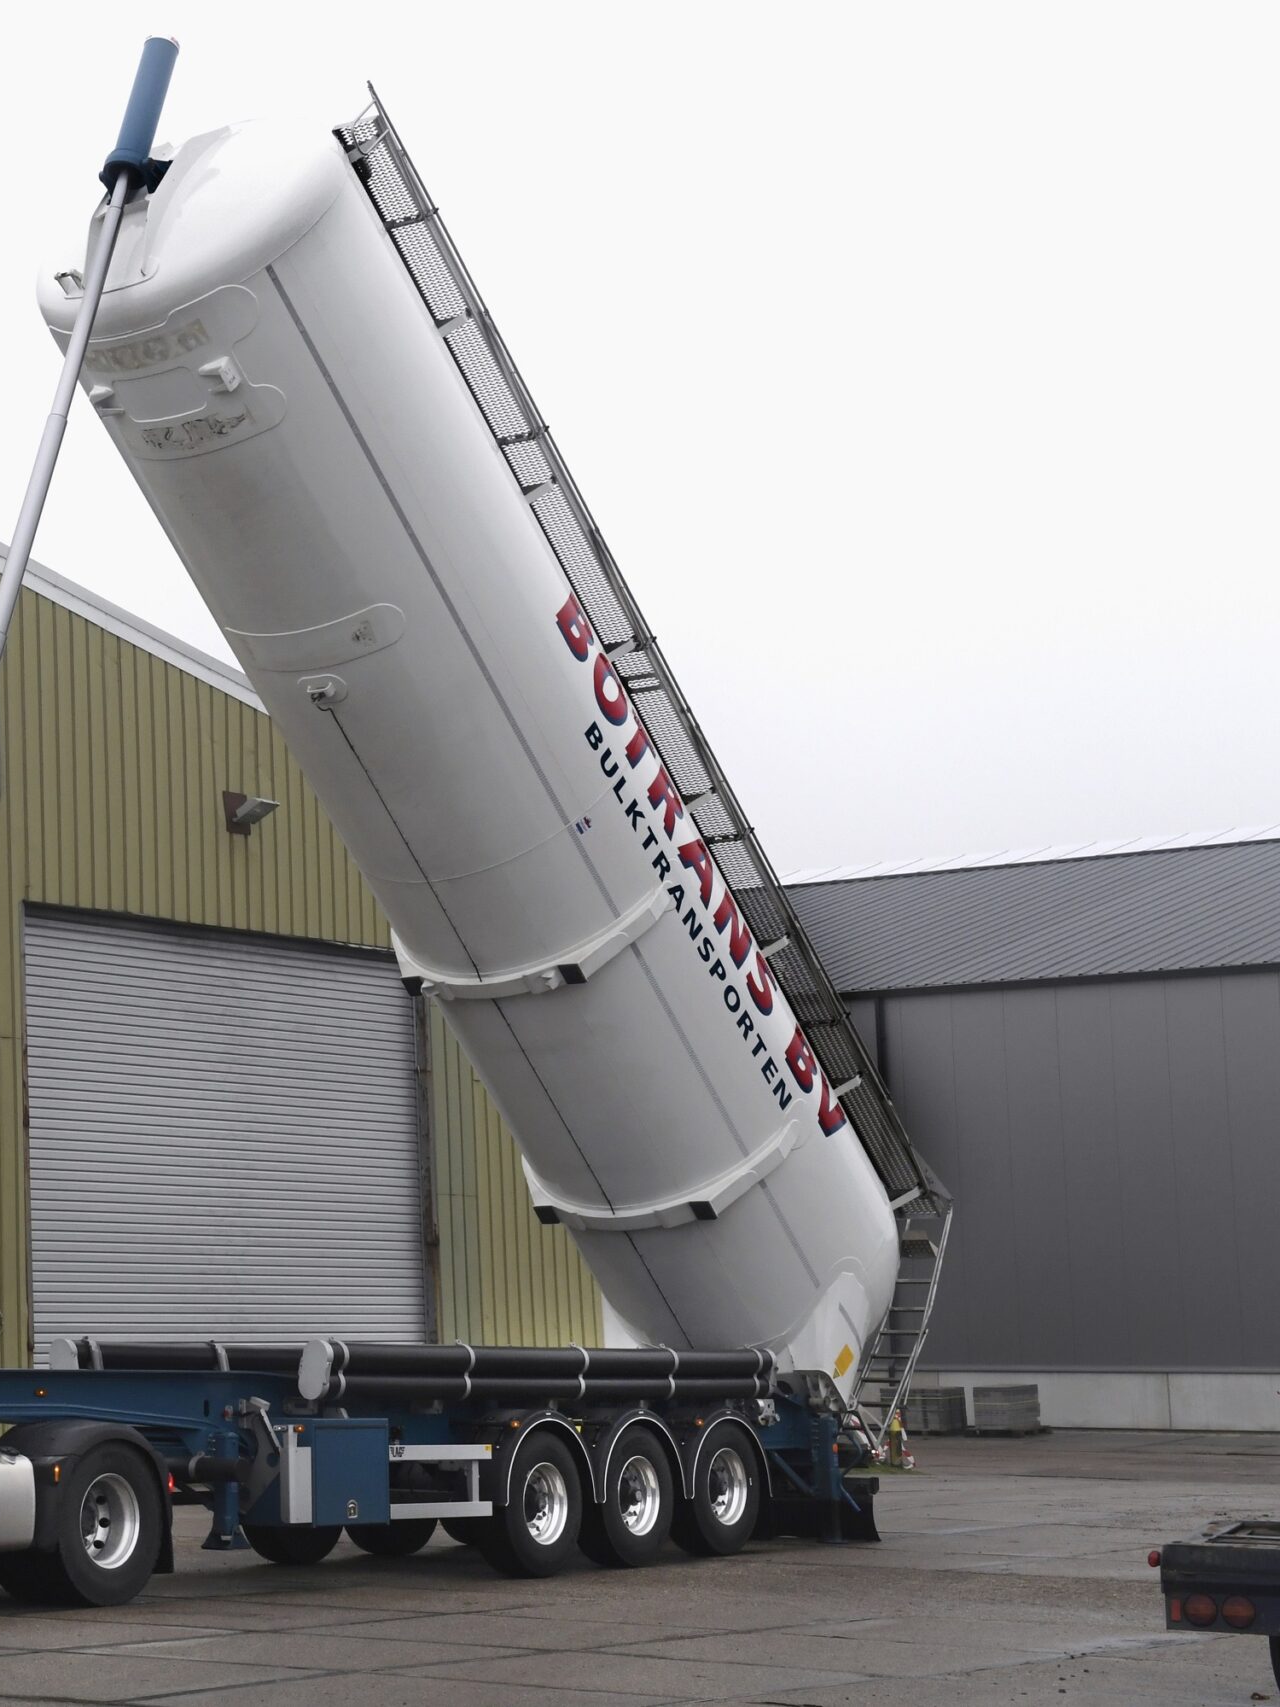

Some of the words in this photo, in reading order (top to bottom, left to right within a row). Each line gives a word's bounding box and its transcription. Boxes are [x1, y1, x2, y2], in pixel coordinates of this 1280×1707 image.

[556, 591, 778, 1018] BOTRANS
[784, 1022, 848, 1138] BV
[584, 720, 793, 1111] BULKTRANSPORTEN
